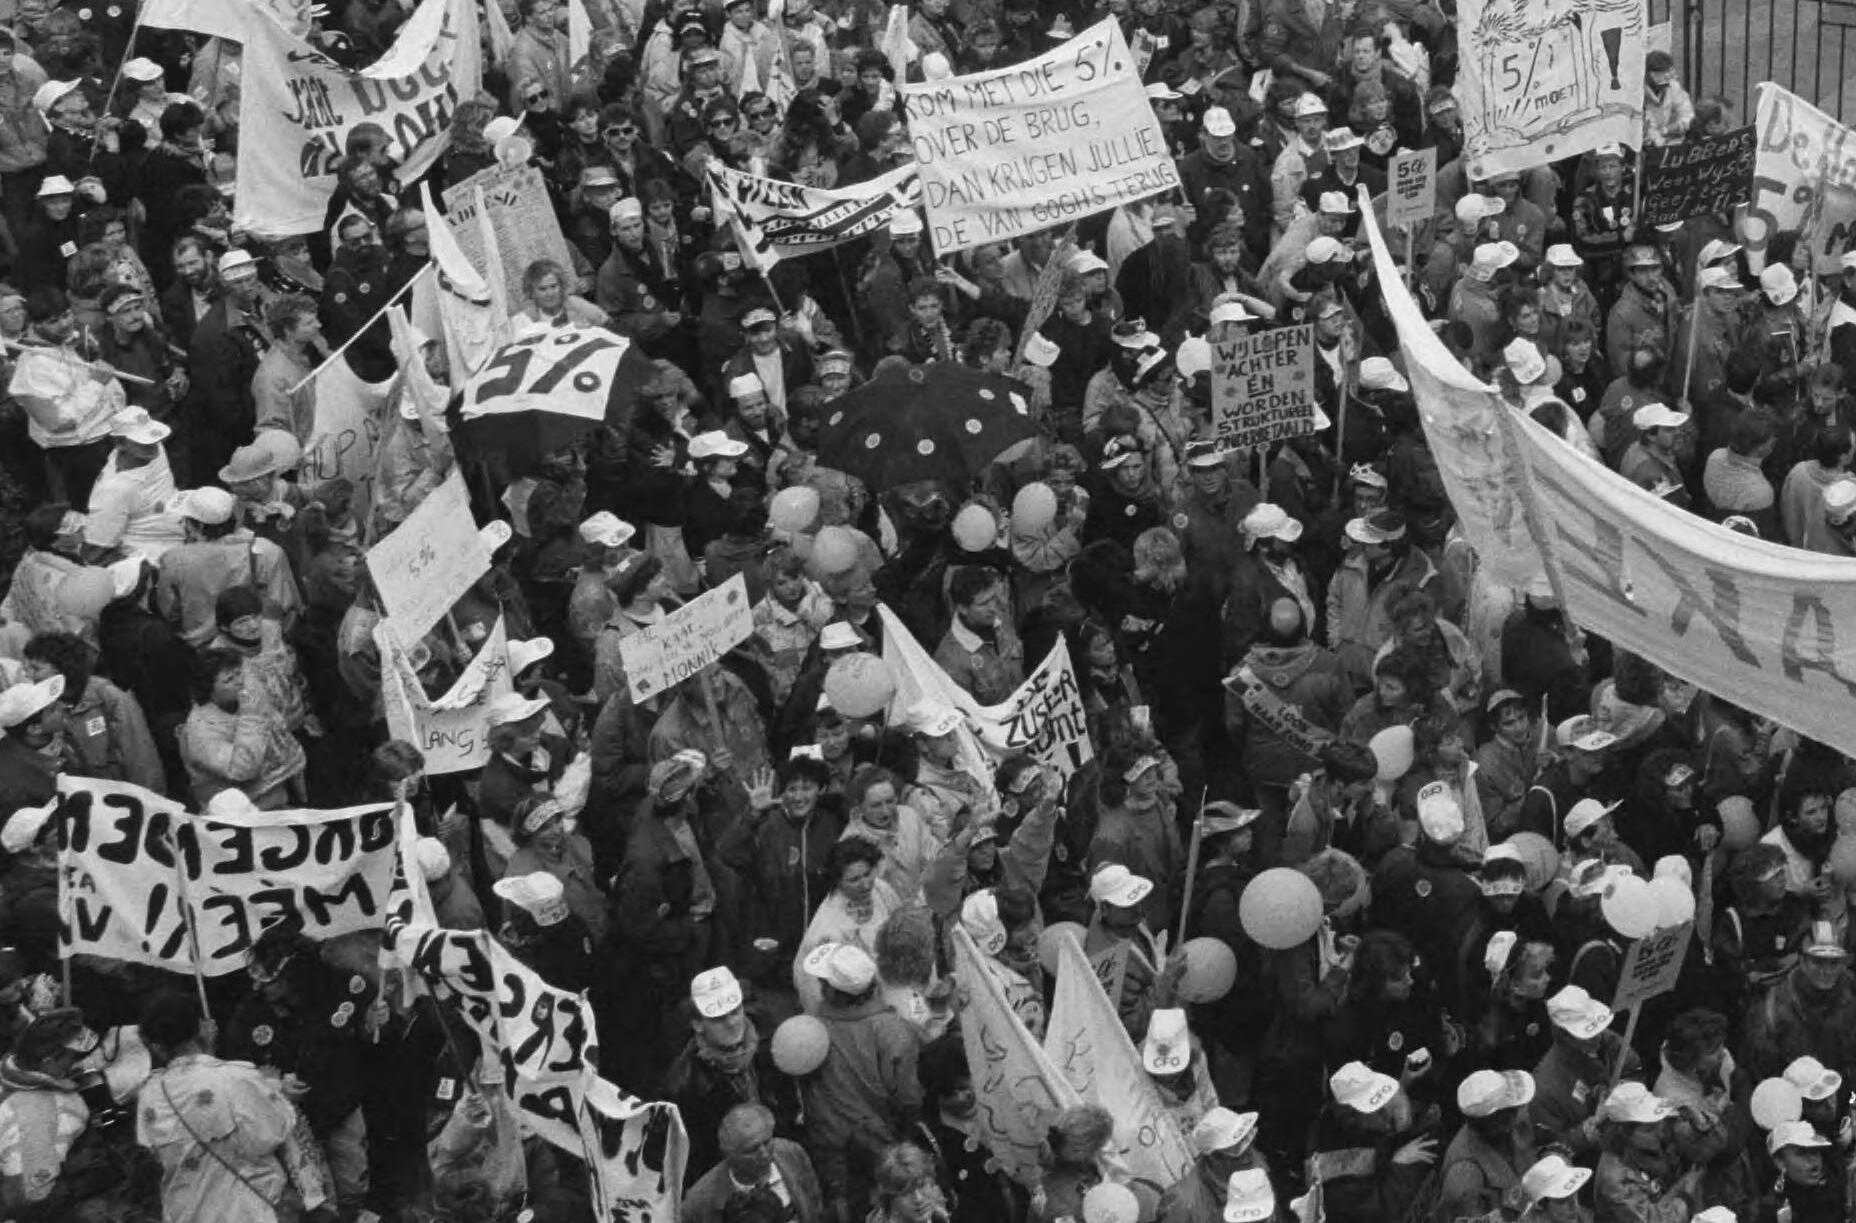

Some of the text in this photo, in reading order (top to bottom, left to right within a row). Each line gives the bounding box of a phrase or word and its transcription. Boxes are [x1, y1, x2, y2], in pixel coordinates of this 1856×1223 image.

[1020, 59, 1064, 99] DIE
[912, 124, 980, 167] OVER
[984, 116, 1016, 145] DE
[926, 178, 986, 211] DAN
[990, 151, 1077, 198] KRIJGEN
[1087, 126, 1159, 173] JULLIE
[934, 216, 969, 251] DE
[980, 204, 1024, 238] VAN
[1226, 349, 1300, 380] ACHTER
[1221, 389, 1307, 419] WORDEN
[1152, 1055, 1181, 1068] CFO
[1369, 1084, 1393, 1105] CFO
